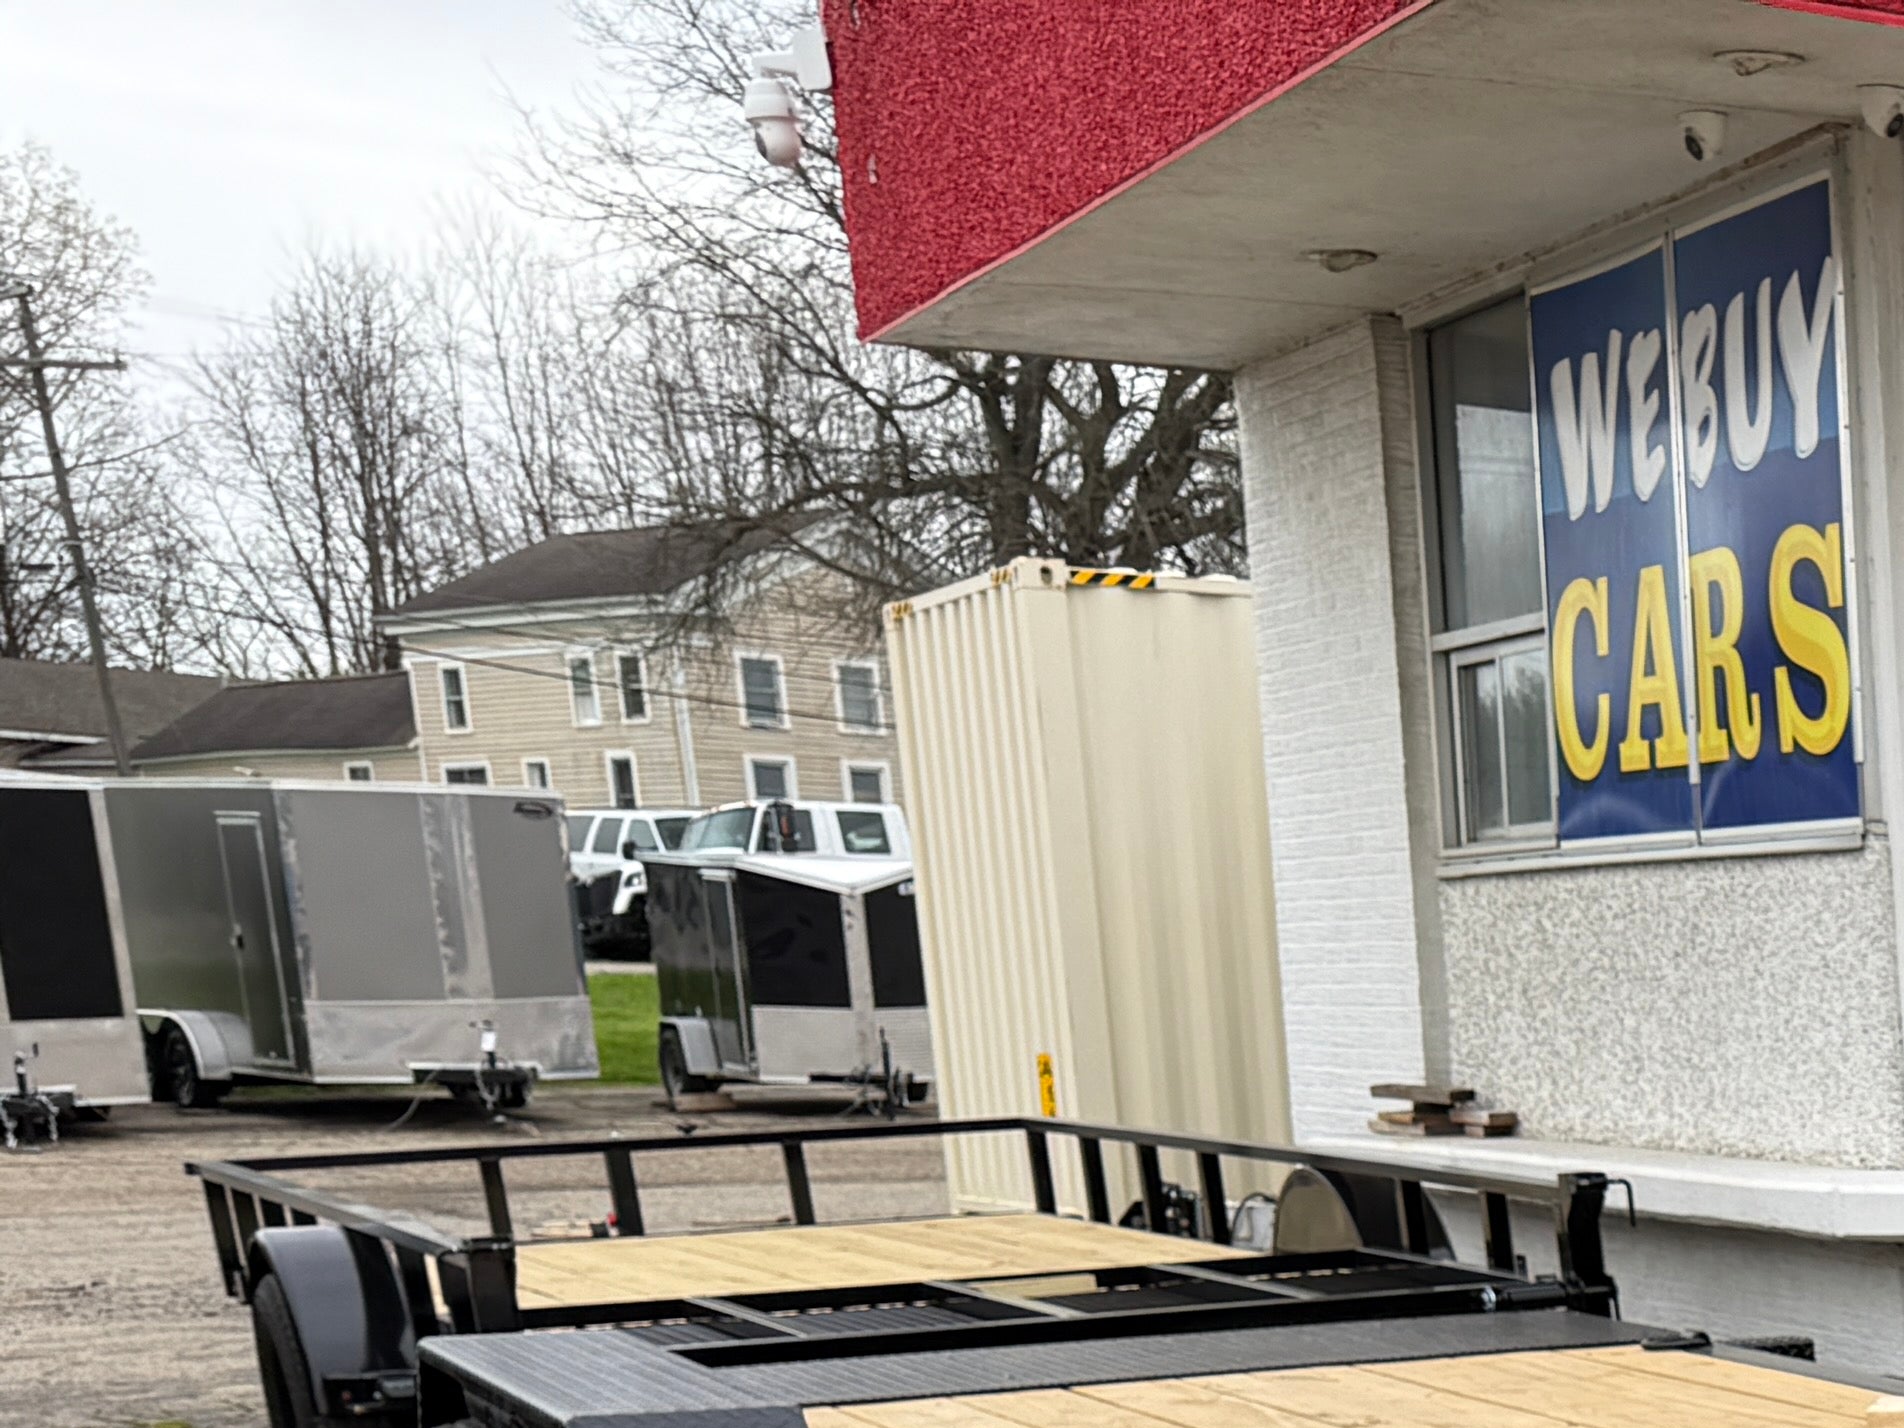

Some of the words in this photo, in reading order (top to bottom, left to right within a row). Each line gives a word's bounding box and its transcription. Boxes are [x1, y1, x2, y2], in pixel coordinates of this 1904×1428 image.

[1551, 329, 1665, 522] WE
[1681, 257, 1835, 488] BUY
[1552, 522, 1850, 781] CARS
